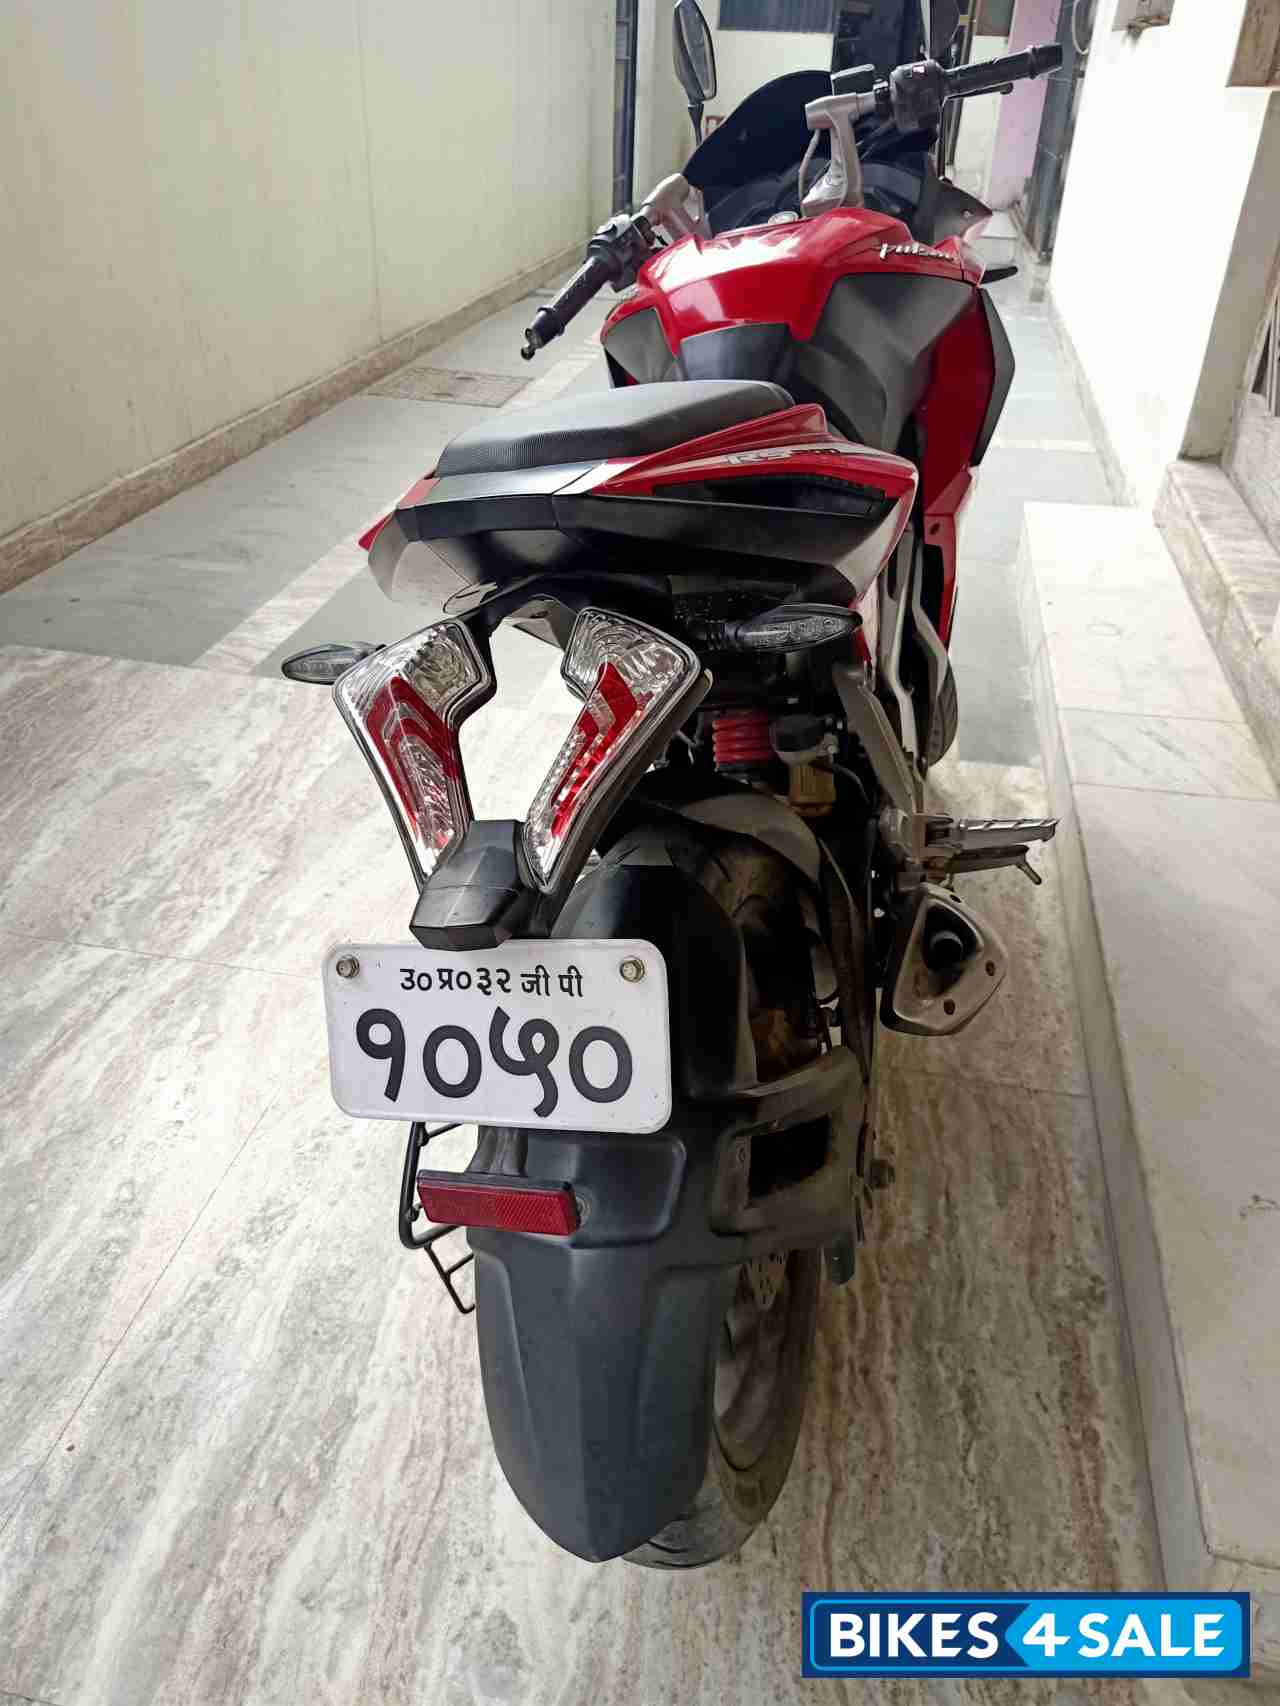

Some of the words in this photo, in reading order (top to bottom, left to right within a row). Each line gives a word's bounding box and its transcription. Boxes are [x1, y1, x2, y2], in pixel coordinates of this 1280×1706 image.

[520, 964, 551, 997] जी
[558, 964, 584, 998] पी
[356, 1006, 633, 1118] १०५०
